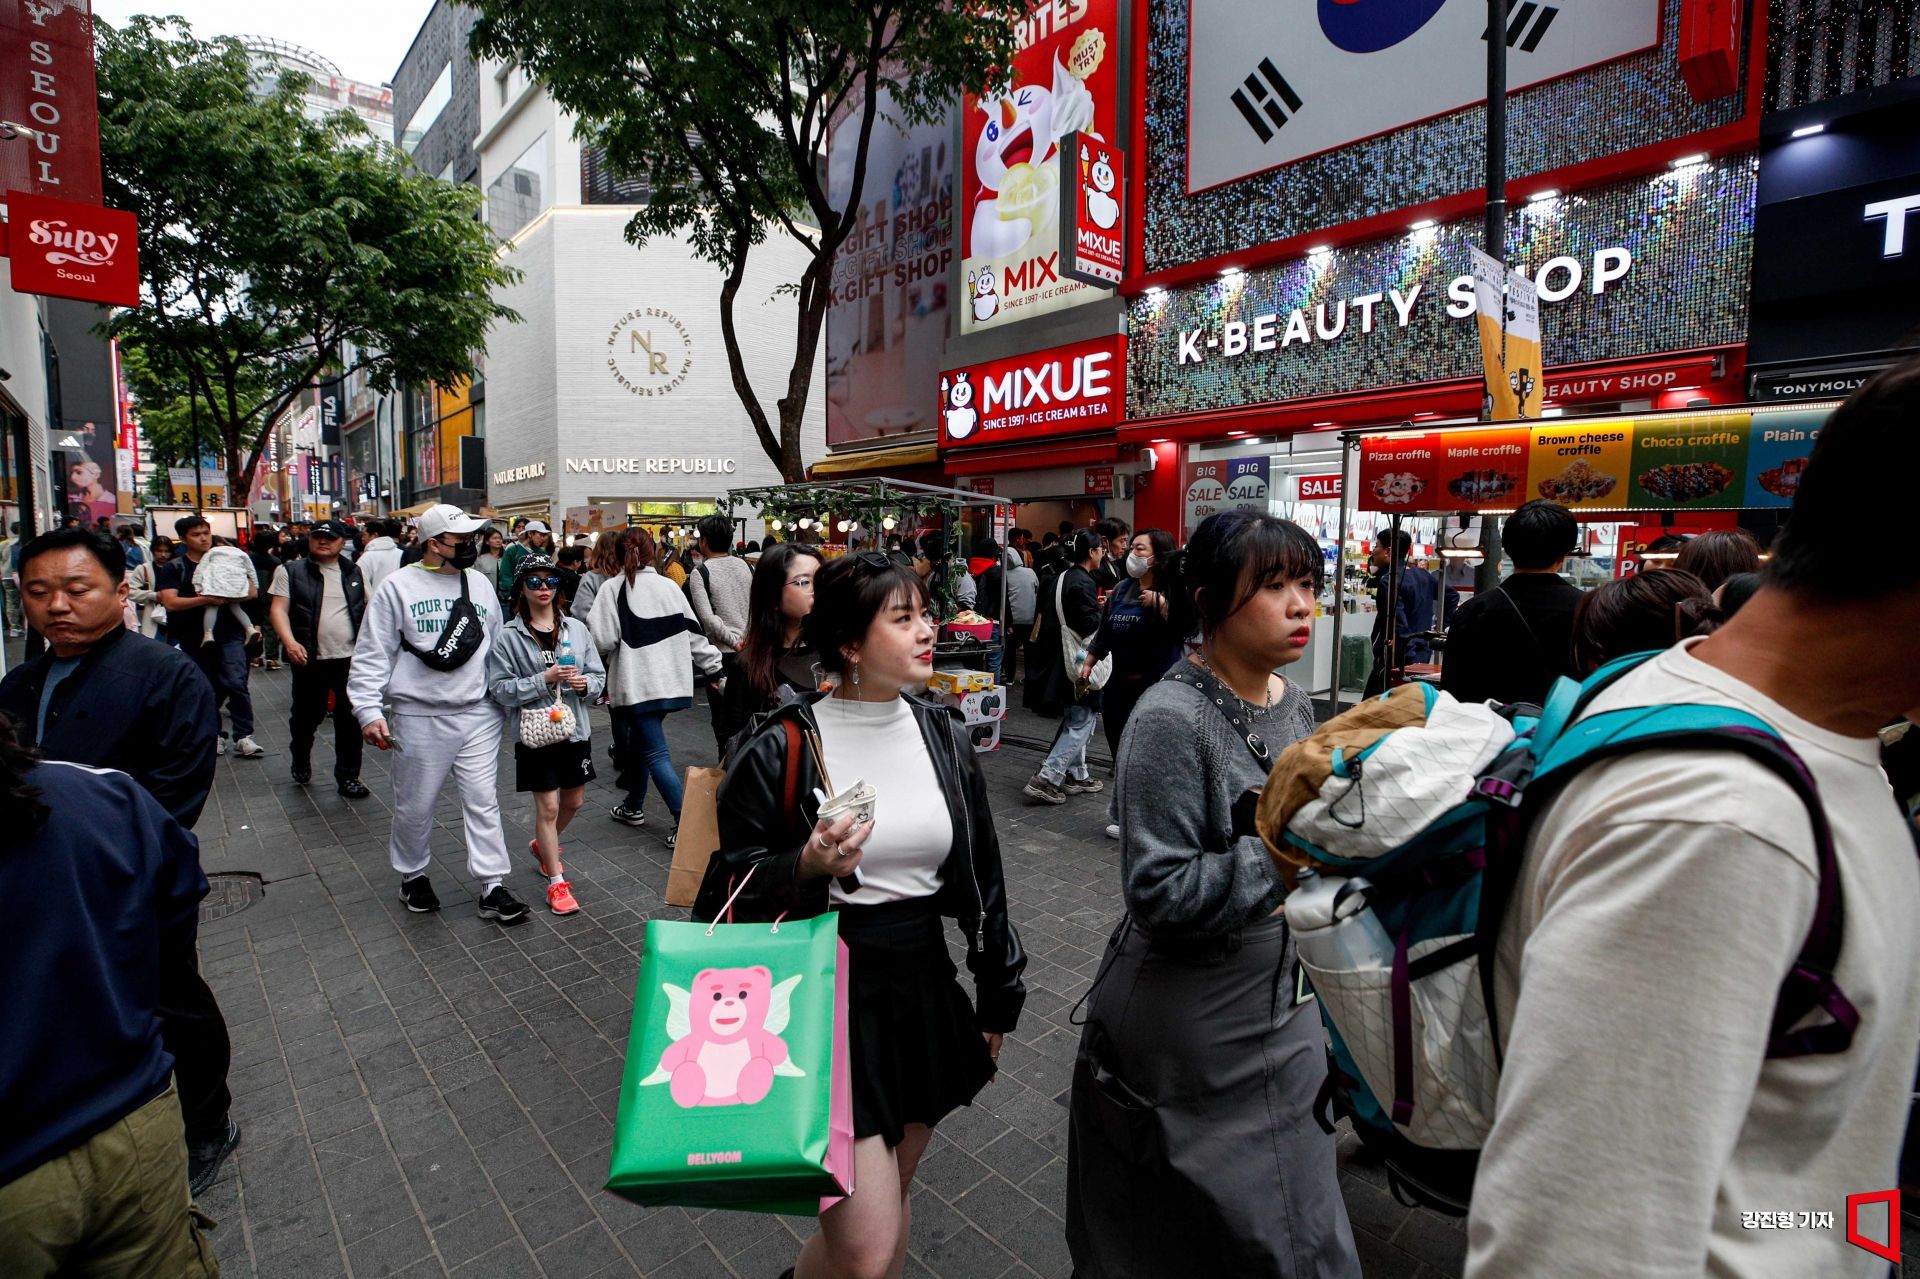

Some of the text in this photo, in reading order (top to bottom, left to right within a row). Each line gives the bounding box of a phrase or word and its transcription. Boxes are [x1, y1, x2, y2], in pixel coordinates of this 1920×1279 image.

[1073, 39, 1099, 66] MUST
[1078, 53, 1096, 71] TRY
[30, 41, 61, 186] SEOUL
[895, 196, 952, 237] SHOP
[28, 219, 119, 265] Supy
[894, 223, 952, 262] SHOP
[1078, 227, 1121, 259] MIXUE
[56, 268, 96, 283] Seoul
[828, 248, 952, 309] K-GIFT SHOP
[1004, 298, 1023, 310] SINCE
[1024, 294, 1038, 304] 1997
[1042, 289, 1053, 300] ICE
[1055, 283, 1081, 295] CREAM
[1178, 247, 1632, 365] K-BEAUTY SOP
[607, 307, 692, 397] NATURE REPUBLIC NATURE REPUBLIC
[983, 351, 1112, 414] MIXUE
[1619, 372, 1677, 390] SHOP
[1773, 378, 1866, 395] TONYMOLY
[324, 395, 337, 427] FILA
[983, 403, 1108, 430] SINCE 1997 ICE CREAM & TEA
[1537, 431, 1624, 446] Brown cheese
[1641, 432, 1740, 449] Choco croffle
[1763, 429, 1806, 443] Plain
[1368, 449, 1431, 461] Pizza croffle
[1447, 444, 1522, 459] Maple croffle
[1557, 444, 1601, 456] croffle
[493, 462, 547, 486] NATURE REPUBLIC
[565, 458, 736, 474] NATURE REPUBLIC
[1197, 466, 1217, 477] BIG
[1238, 463, 1259, 474] BIG
[1188, 487, 1223, 502] SALE
[1228, 485, 1266, 500] SALE
[1301, 480, 1342, 496] SALE
[1194, 504, 1216, 517] 80%
[410, 599, 442, 618] YOUR
[437, 616, 470, 659] Supreme
